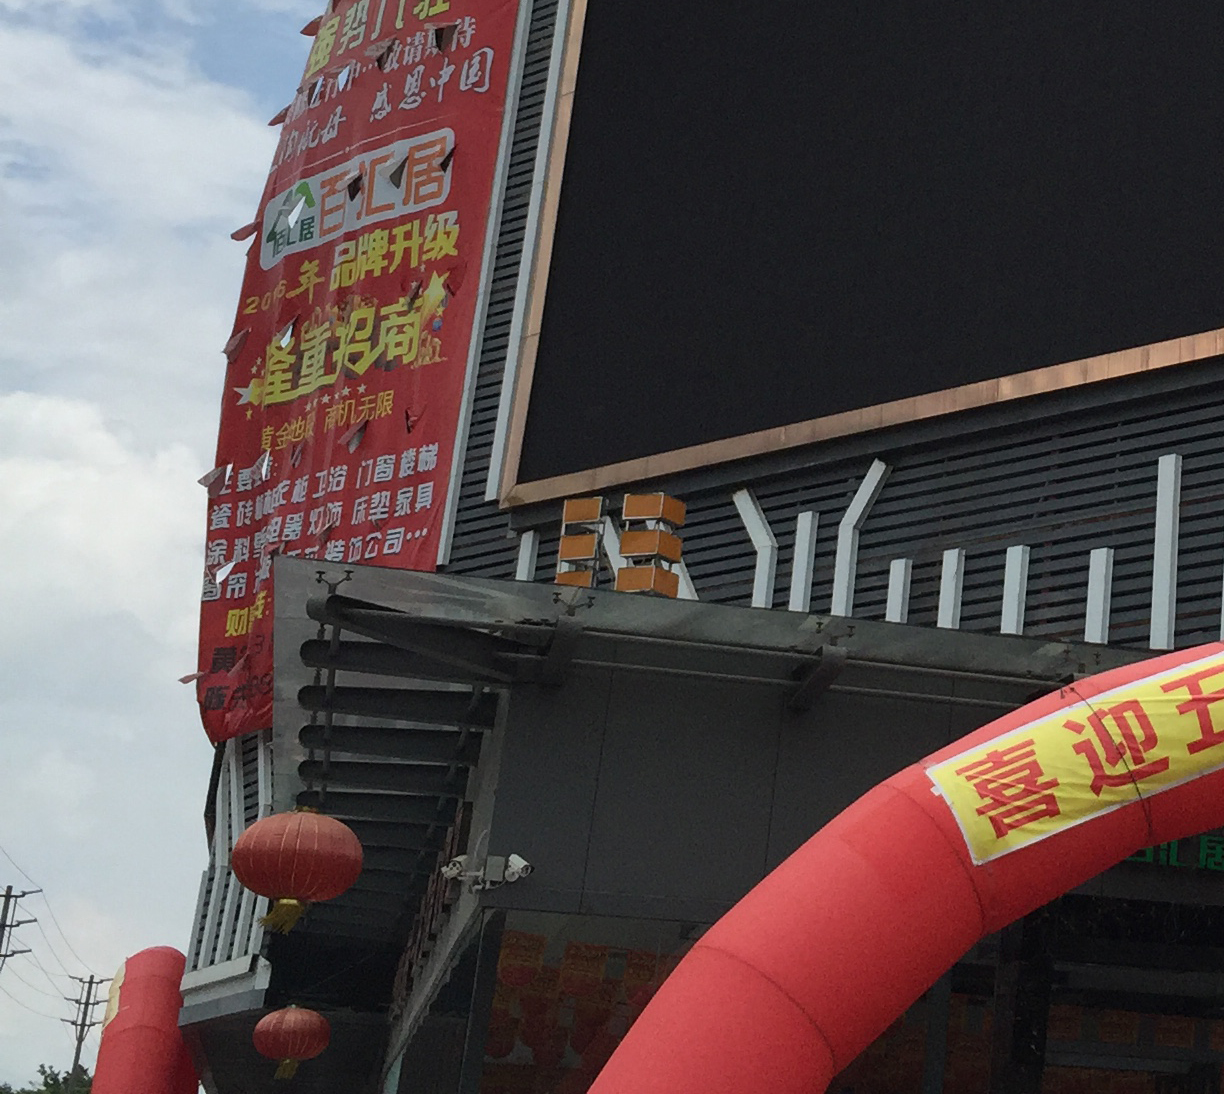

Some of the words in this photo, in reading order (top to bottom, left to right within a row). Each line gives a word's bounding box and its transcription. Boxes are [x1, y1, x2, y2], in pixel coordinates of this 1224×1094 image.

[318, 136, 449, 238] 百汇居
[329, 210, 460, 292] 品牌升级
[262, 296, 425, 408] 隆重招商
[324, 389, 396, 433] 商机无限
[312, 464, 349, 500] 卫浴
[355, 453, 398, 490] 门窗
[398, 442, 439, 479] 楼梯
[350, 490, 392, 527] 床垫
[393, 481, 435, 518] 家具
